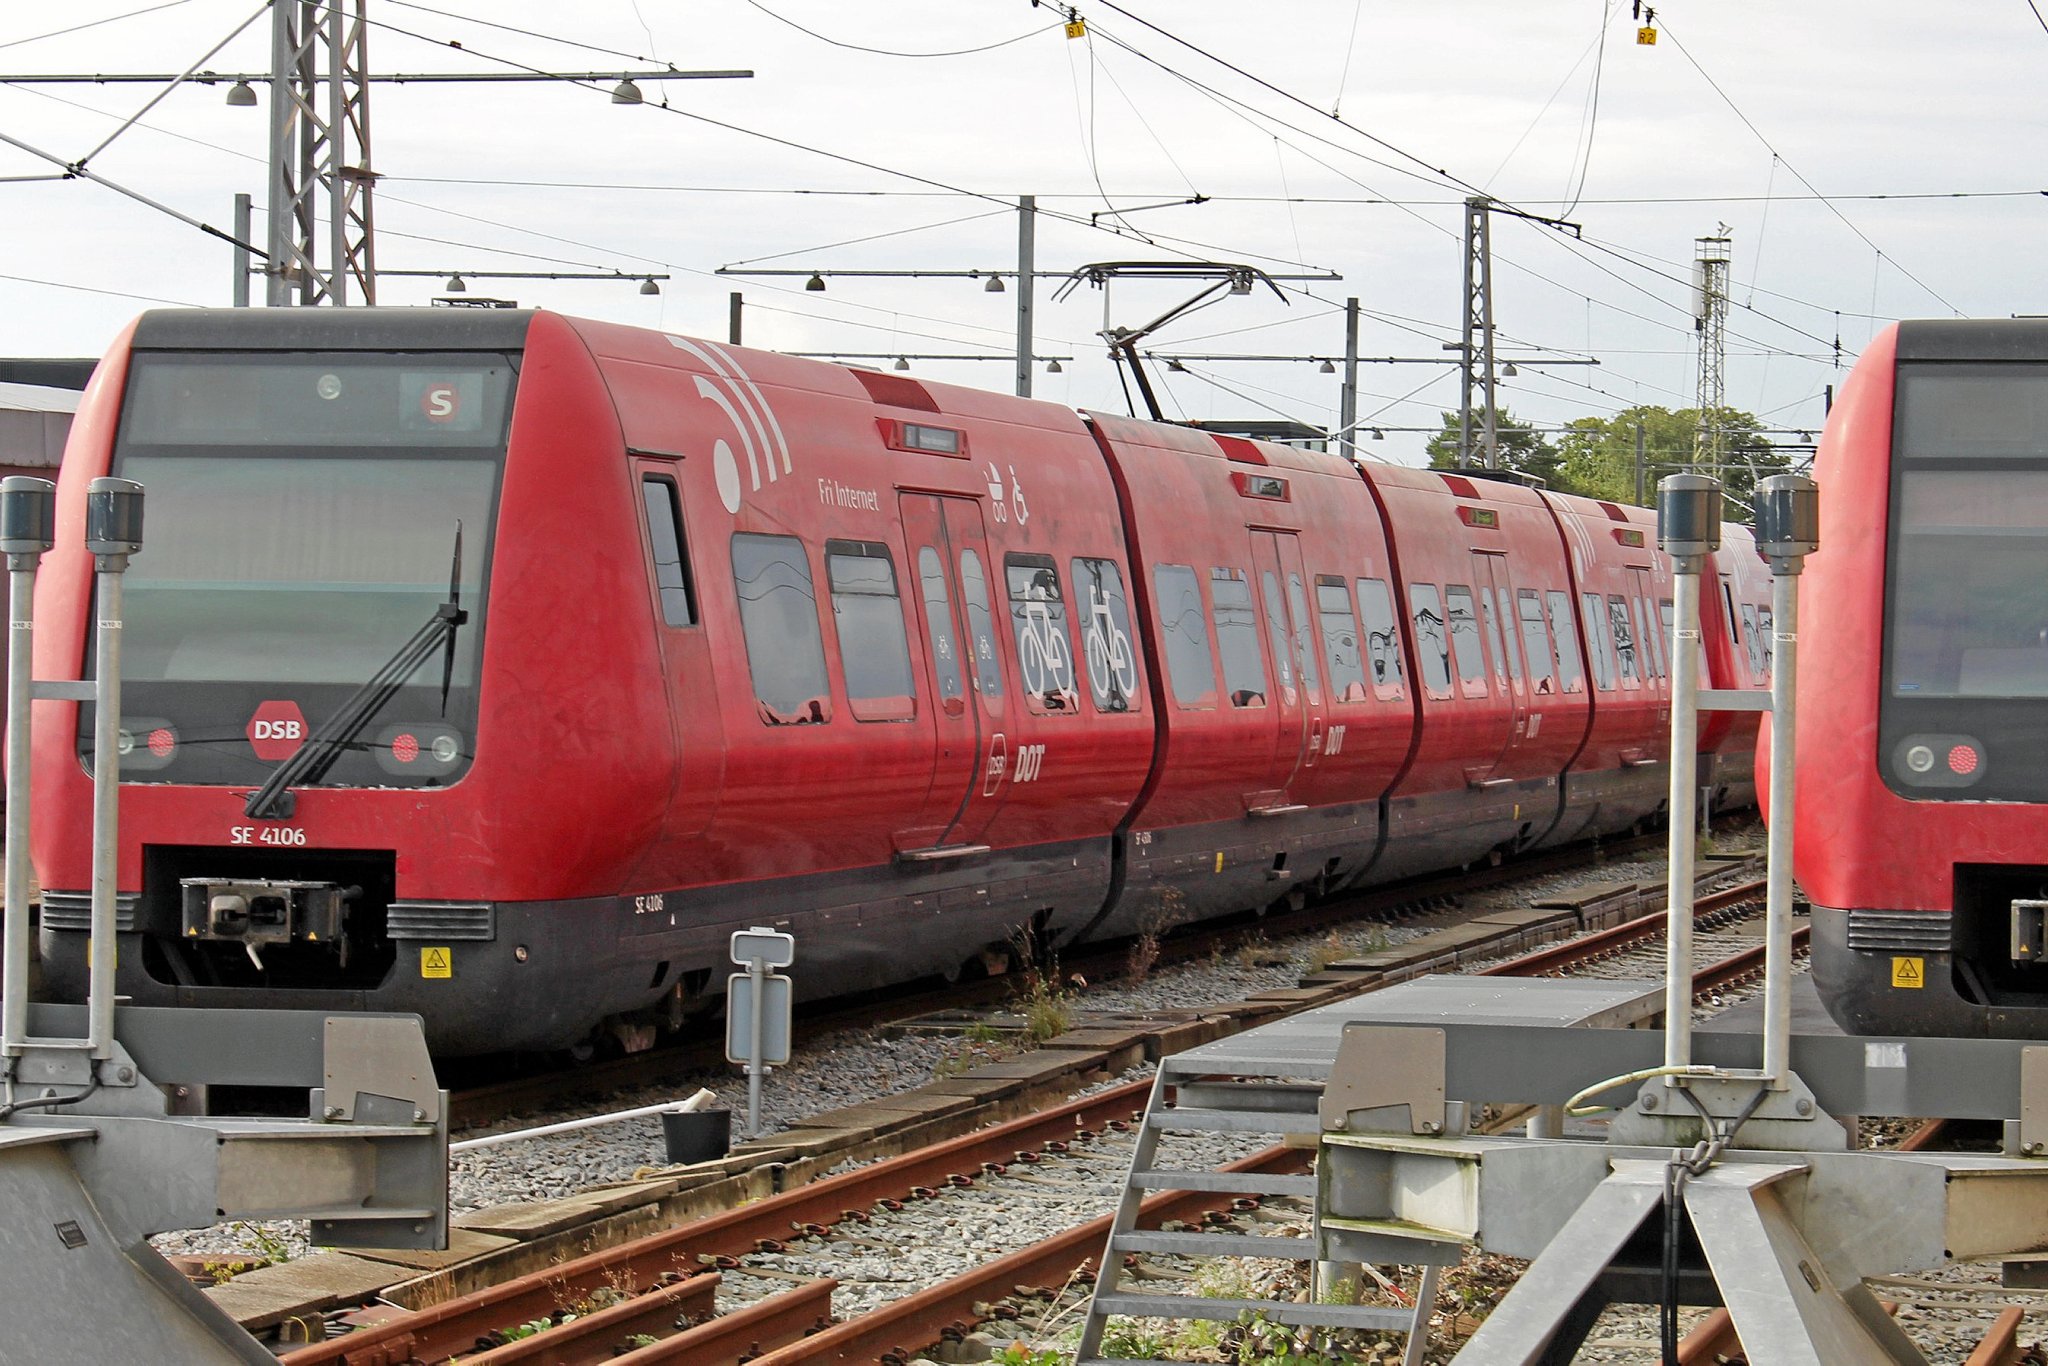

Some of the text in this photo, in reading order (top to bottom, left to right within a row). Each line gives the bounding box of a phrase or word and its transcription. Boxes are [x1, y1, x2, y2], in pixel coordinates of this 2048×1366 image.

[1639, 32, 1653, 44] R2
[429, 389, 452, 416] S
[818, 478, 880, 511] Fri Internet
[254, 720, 301, 740] DSB
[989, 755, 1005, 775] DSB
[1013, 744, 1045, 783] DOT
[230, 826, 306, 846] SE 4106
